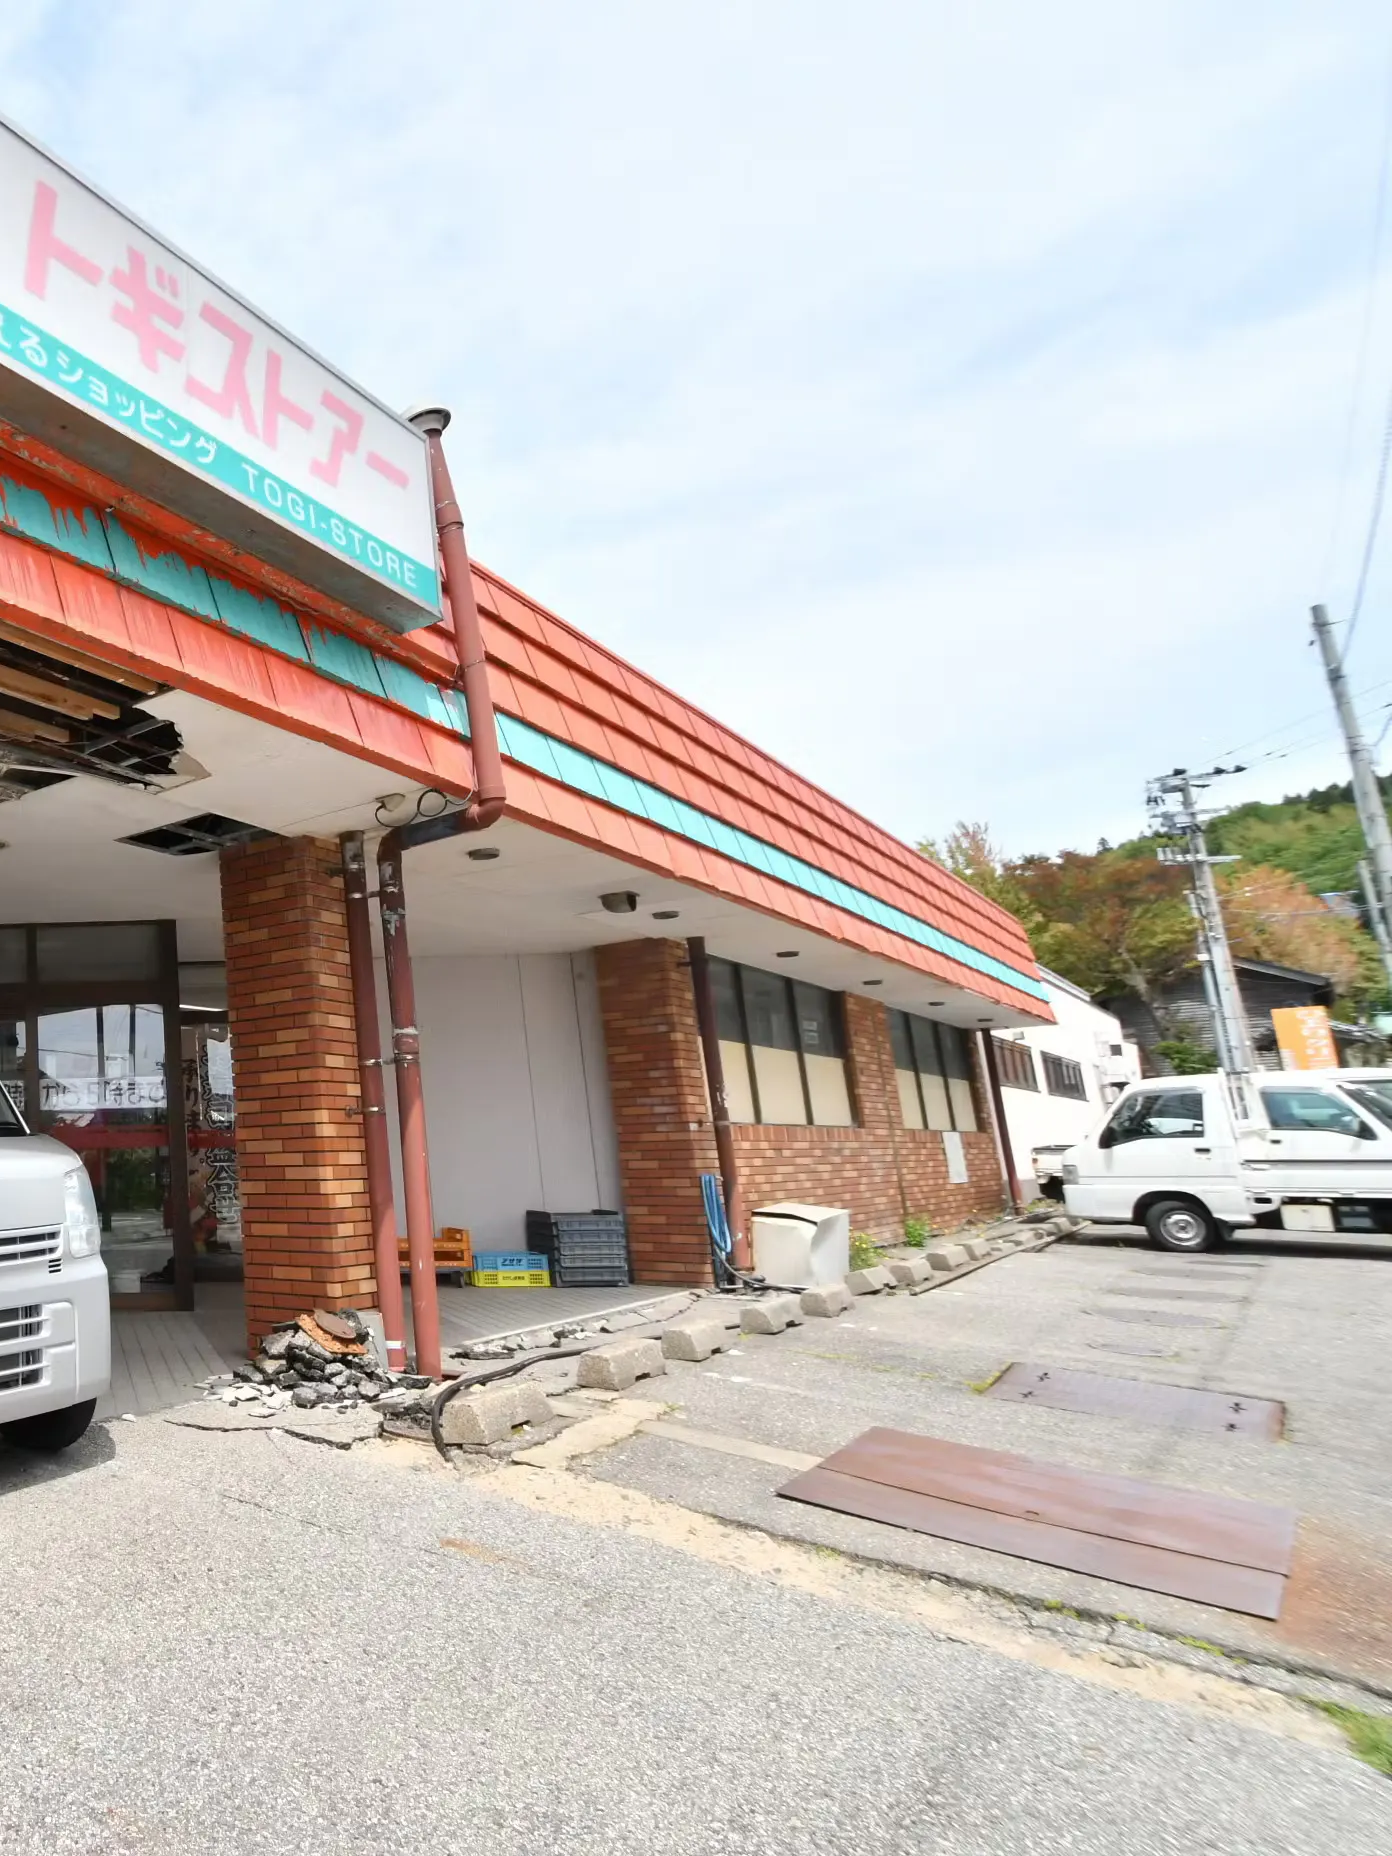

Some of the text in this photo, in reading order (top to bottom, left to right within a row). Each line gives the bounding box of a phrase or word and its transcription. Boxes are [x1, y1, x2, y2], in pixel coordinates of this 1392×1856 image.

[24, 180, 410, 492] トギストアー
[240, 461, 418, 590] TOGI-STORE
